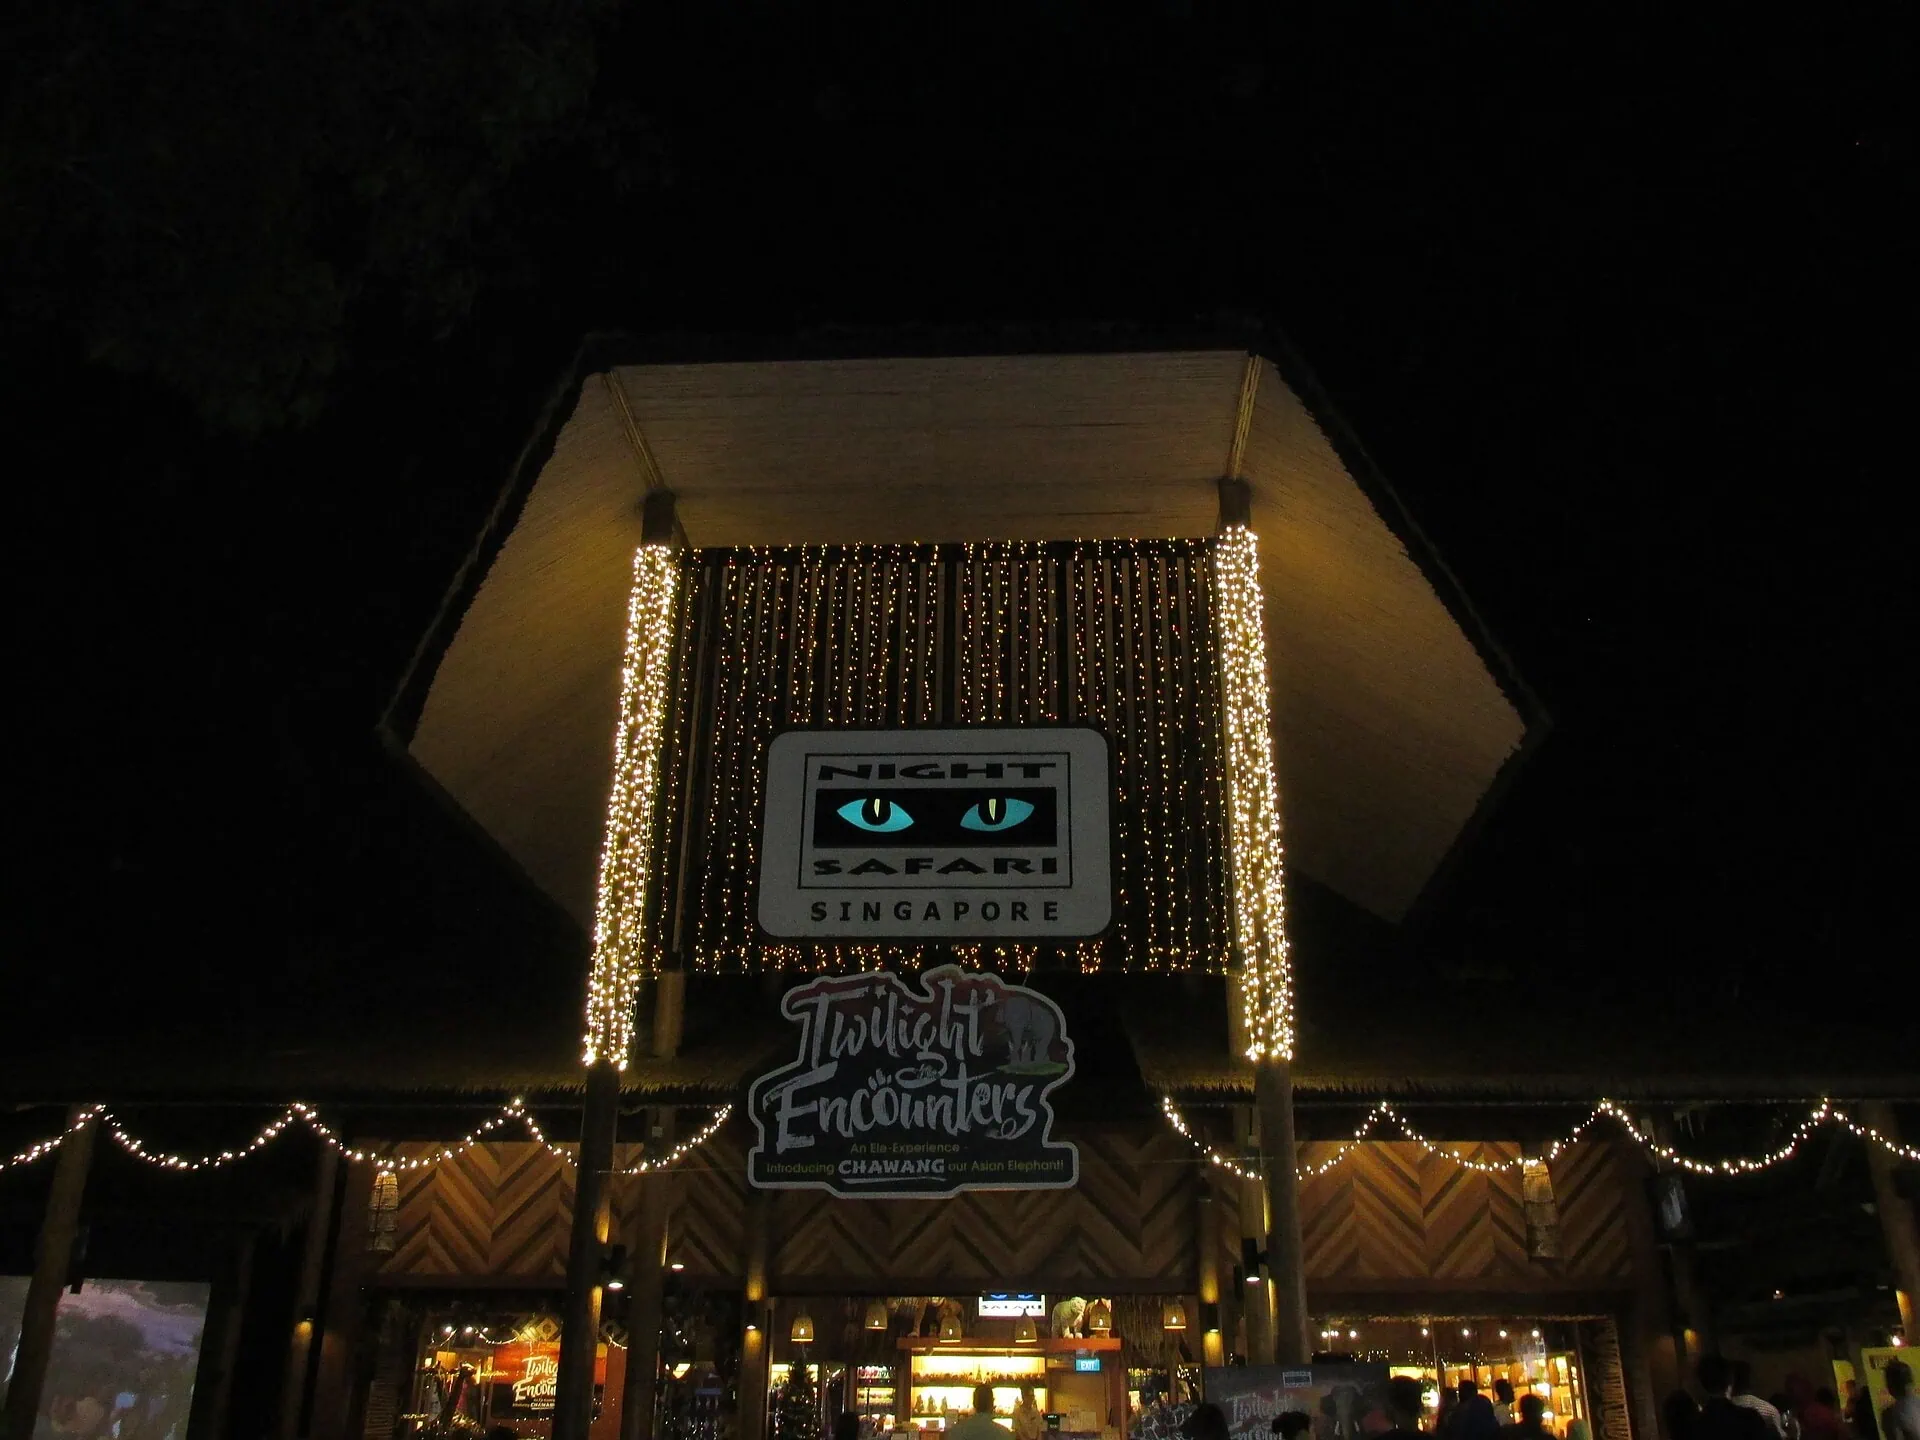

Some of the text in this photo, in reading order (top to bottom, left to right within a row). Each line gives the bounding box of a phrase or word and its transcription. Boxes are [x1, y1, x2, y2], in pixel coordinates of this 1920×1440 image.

[818, 763, 1056, 780] NIGHT
[813, 857, 1058, 875] SAFARI
[810, 901, 1059, 922] SINGAPORE
[791, 978, 997, 1088] Twilight
[762, 1061, 1037, 1154] Encounters
[850, 1143, 867, 1154] An
[766, 1162, 835, 1175] Introducing
[838, 1159, 945, 1175] CHAWANG
[948, 1163, 968, 1172] our
[971, 1160, 1005, 1171] Asian
[1080, 1360, 1096, 1370] EXIT
